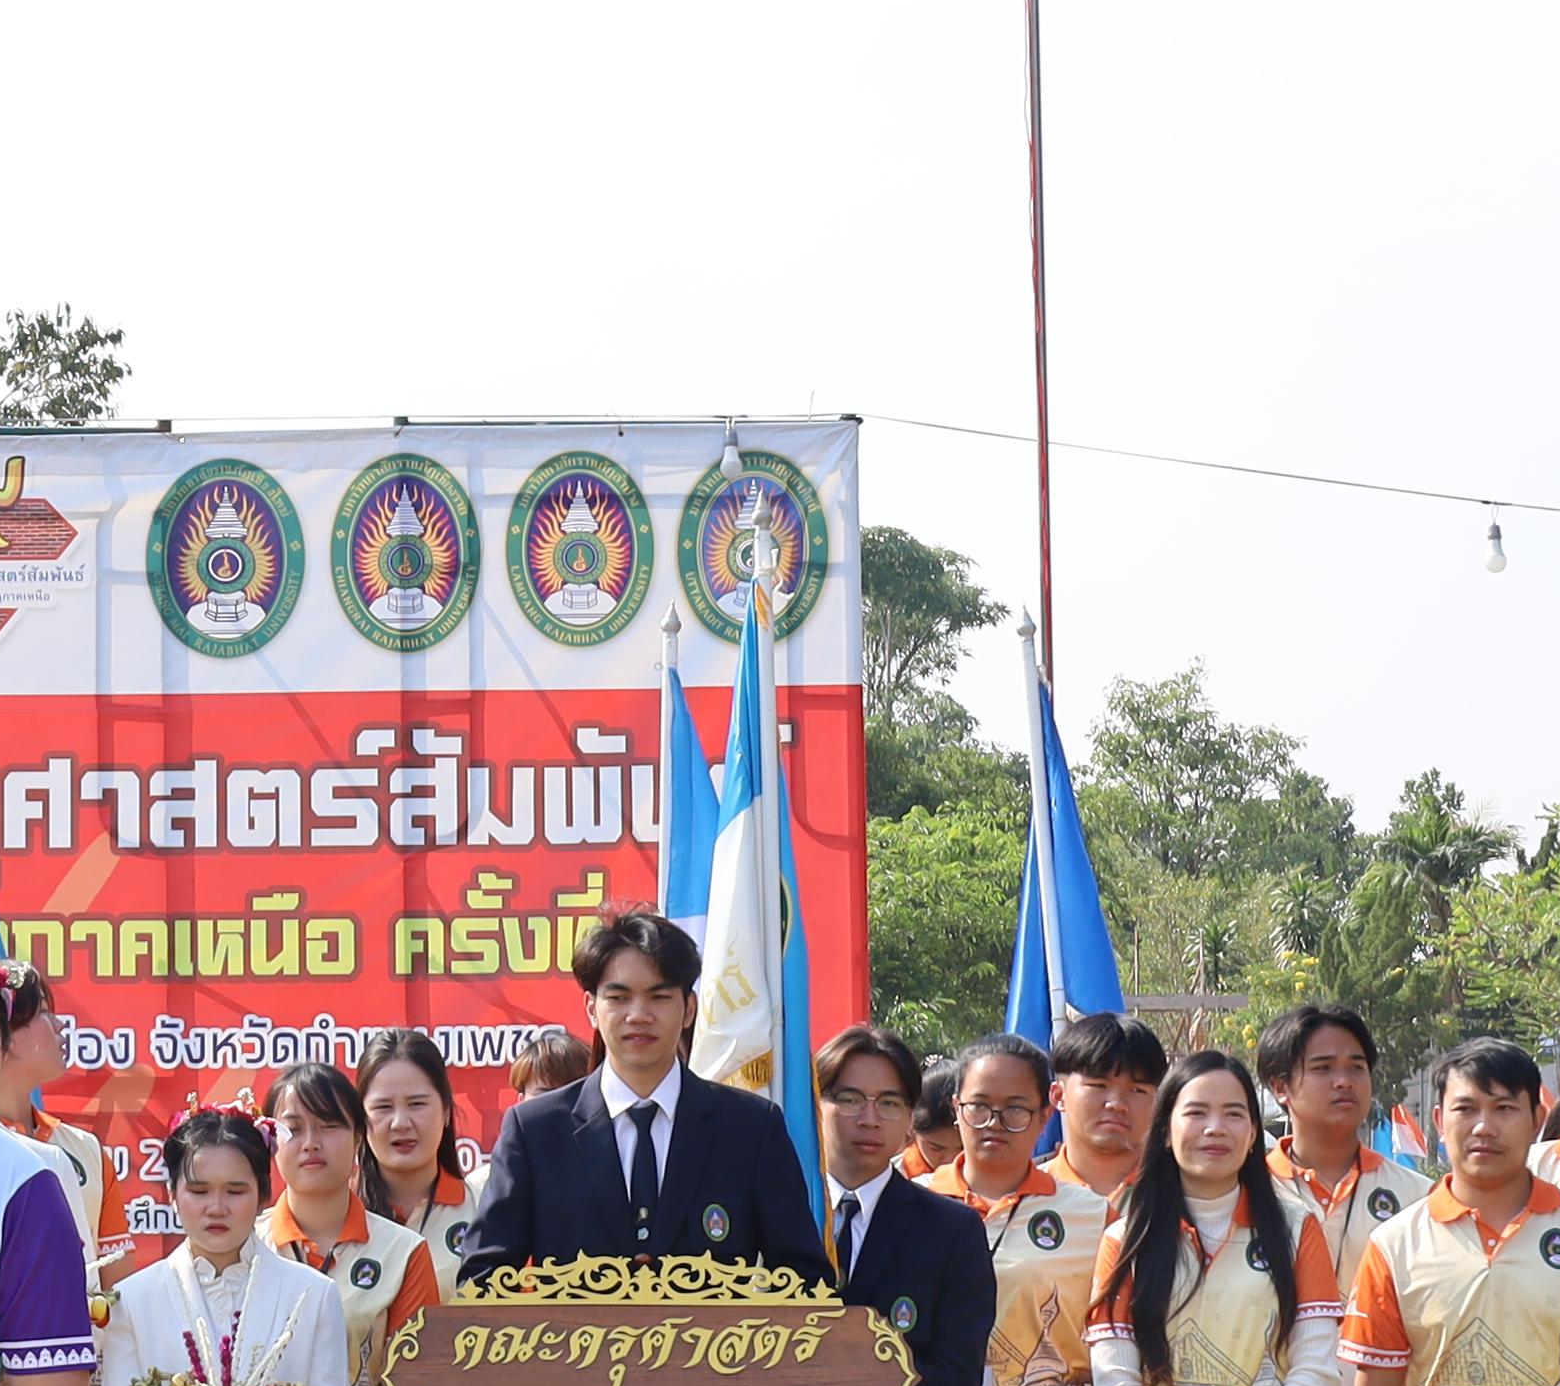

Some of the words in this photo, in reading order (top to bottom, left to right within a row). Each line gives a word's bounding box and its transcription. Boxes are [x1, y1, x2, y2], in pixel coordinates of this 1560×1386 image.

[193, 636, 261, 657] RAJABHAT
[262, 568, 302, 639] UNIVERSITY
[371, 629, 436, 651] RAJABHAT
[436, 563, 478, 637] UNIVERSITY
[510, 564, 544, 624] LAMPANG
[543, 620, 606, 645] RAJABHAT
[607, 563, 651, 633] UNIVERSITY
[684, 570, 726, 631] UTTARADIT
[781, 569, 822, 631] UNIVERSITY
